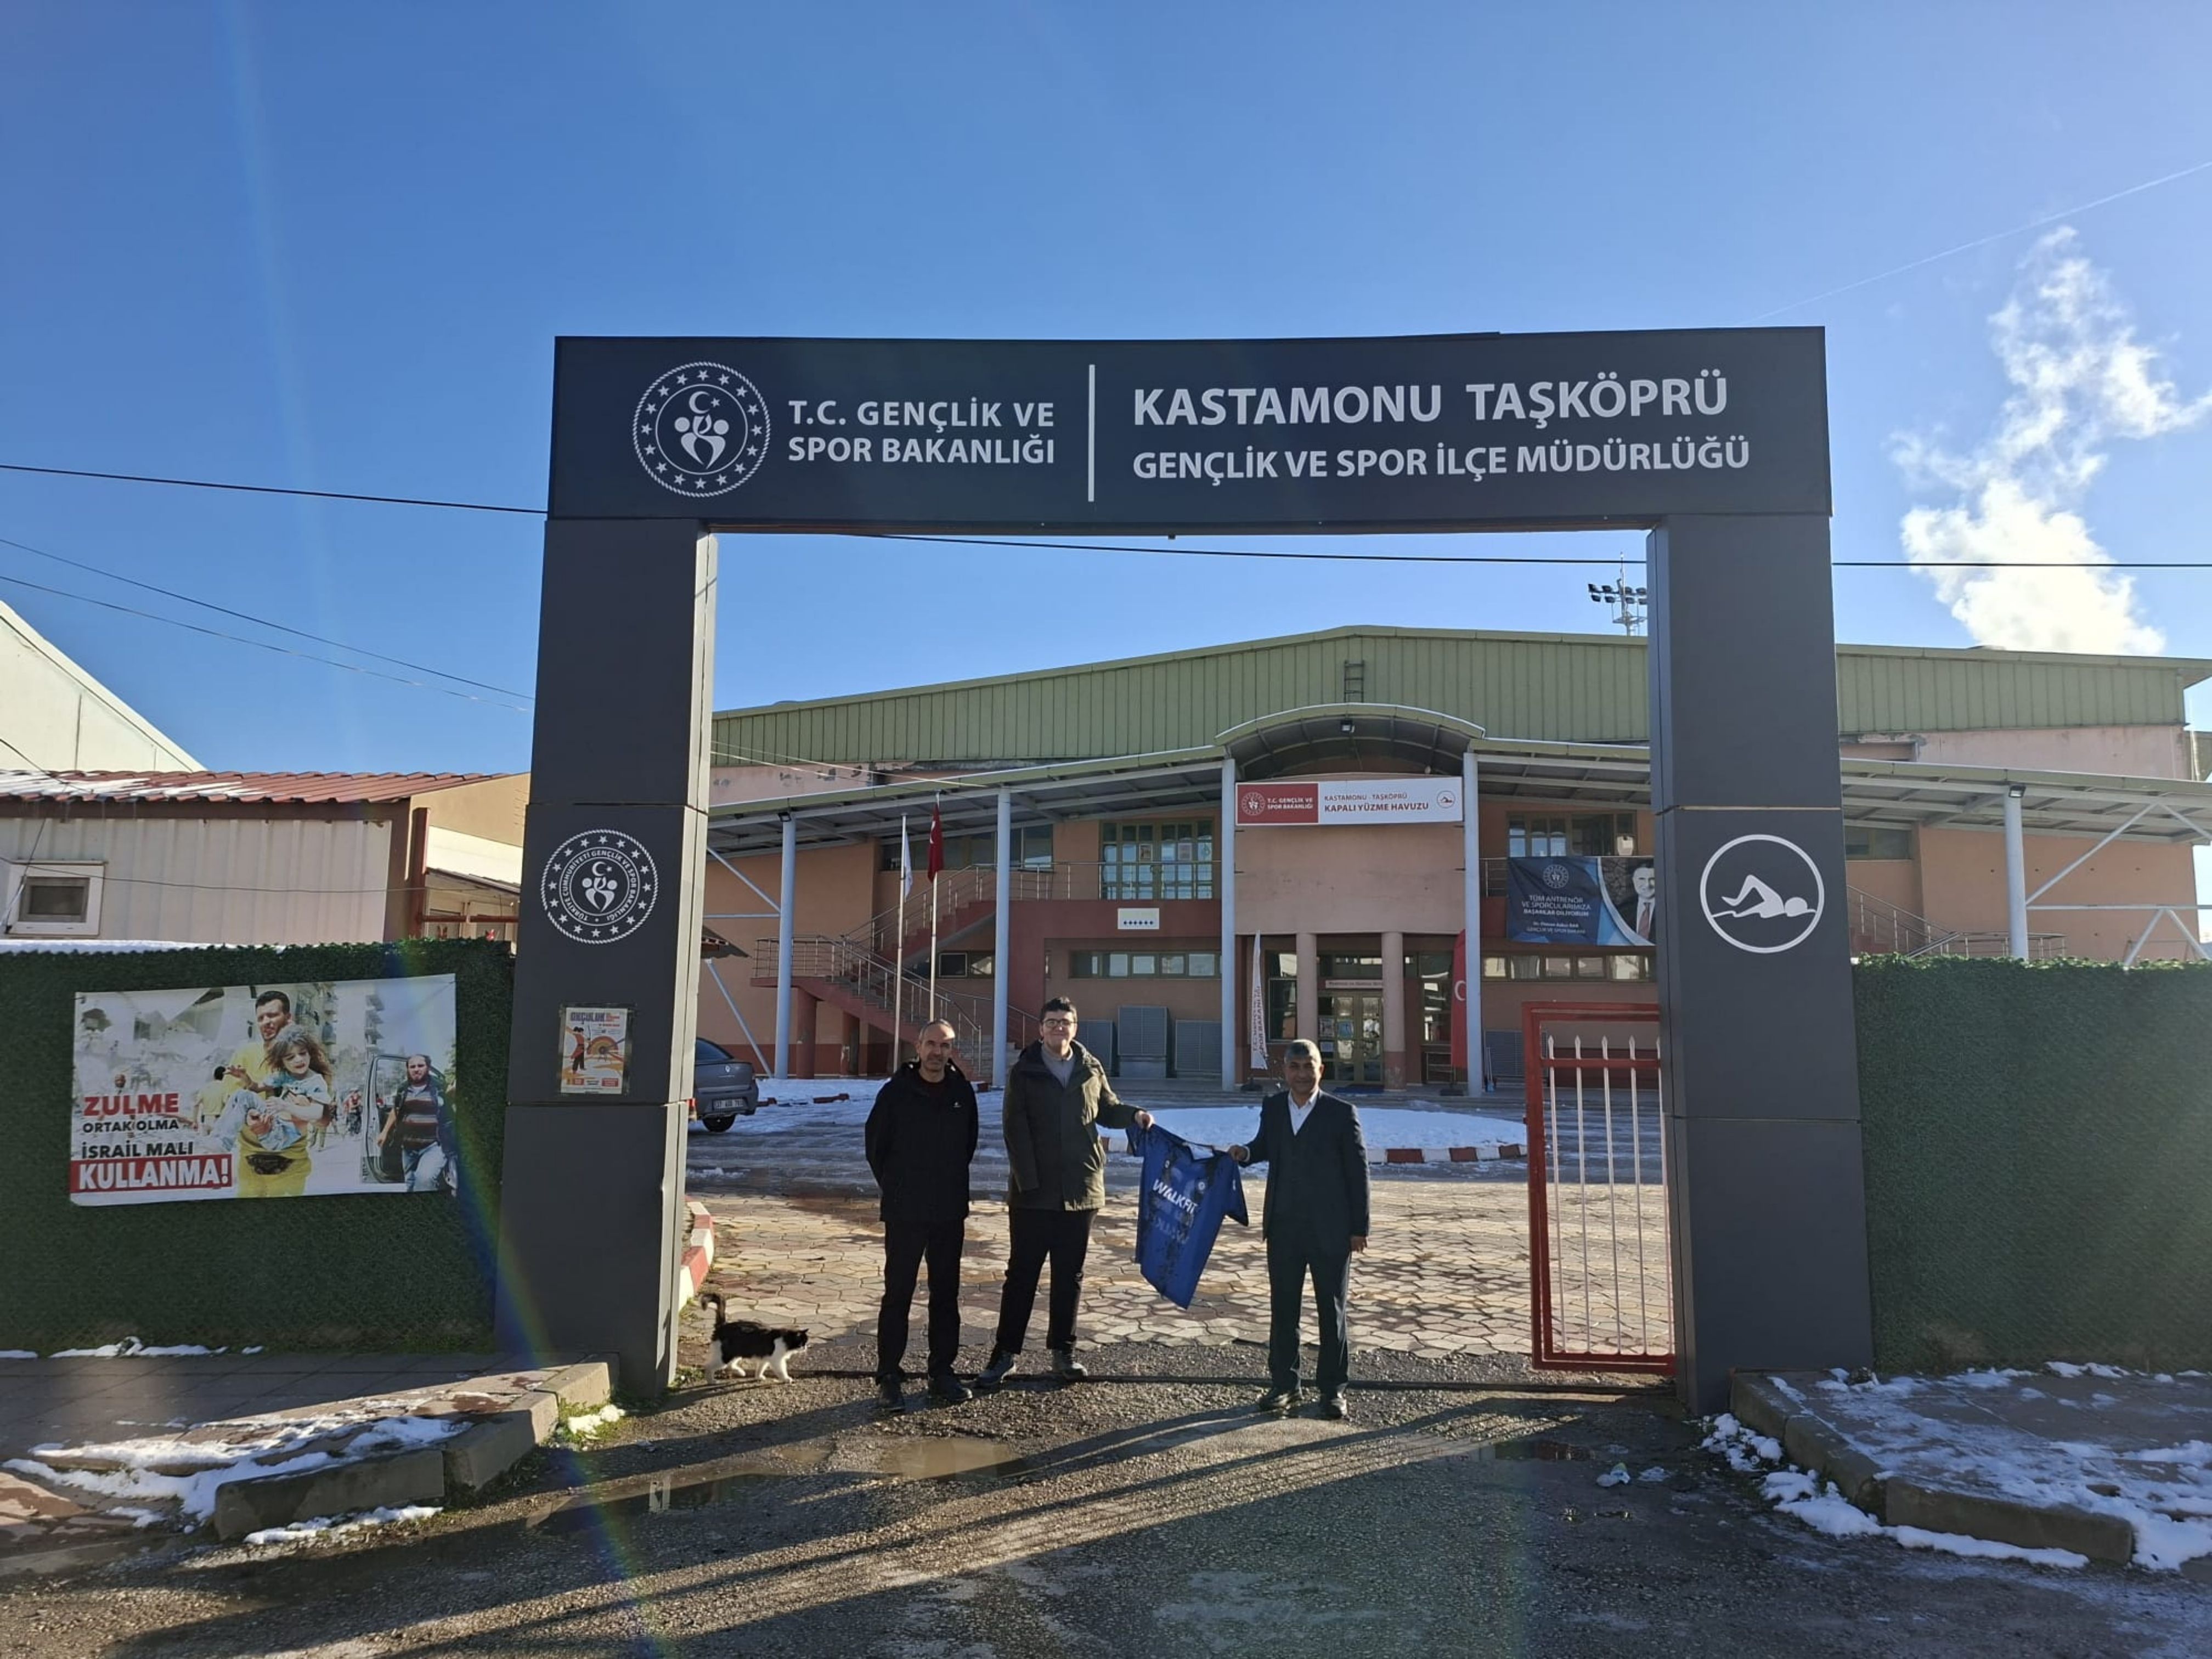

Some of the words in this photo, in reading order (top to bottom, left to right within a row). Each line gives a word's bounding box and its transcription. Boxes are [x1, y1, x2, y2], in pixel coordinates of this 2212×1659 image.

[788, 400, 847, 426] T.C.
[856, 397, 1002, 433] GENÇLİK
[1013, 402, 1054, 427] VE
[1133, 384, 1442, 426] KASTAMONU
[1466, 369, 1728, 429] TAŞKÖPRÜ
[788, 436, 872, 462] SPOR
[882, 433, 1054, 464] BAKANLIĞI
[1133, 445, 1278, 486] GENÇLİK
[1287, 449, 1328, 478] VE
[1337, 448, 1427, 477] SPOR
[1436, 442, 1507, 482] İLÇE
[1516, 435, 1750, 473] MÜDÜRLÜĞÜ
[1324, 804, 1356, 812] KAPALI
[1358, 803, 1390, 811] YÜZME
[1391, 802, 1429, 811] HAVUZU
[591, 850, 623, 861] GENÇLİK
[622, 859, 631, 869] VE
[627, 868, 637, 888] SPOR
[83, 1093, 179, 1117] ZULME
[82, 1121, 132, 1133] ORTAK
[136, 1119, 179, 1131] OLMA
[82, 1140, 141, 1159] İSRAİL
[145, 1141, 194, 1156] MALI
[78, 1158, 229, 1190] KULLANMA!
[1152, 1178, 1199, 1214] WALKFIT
